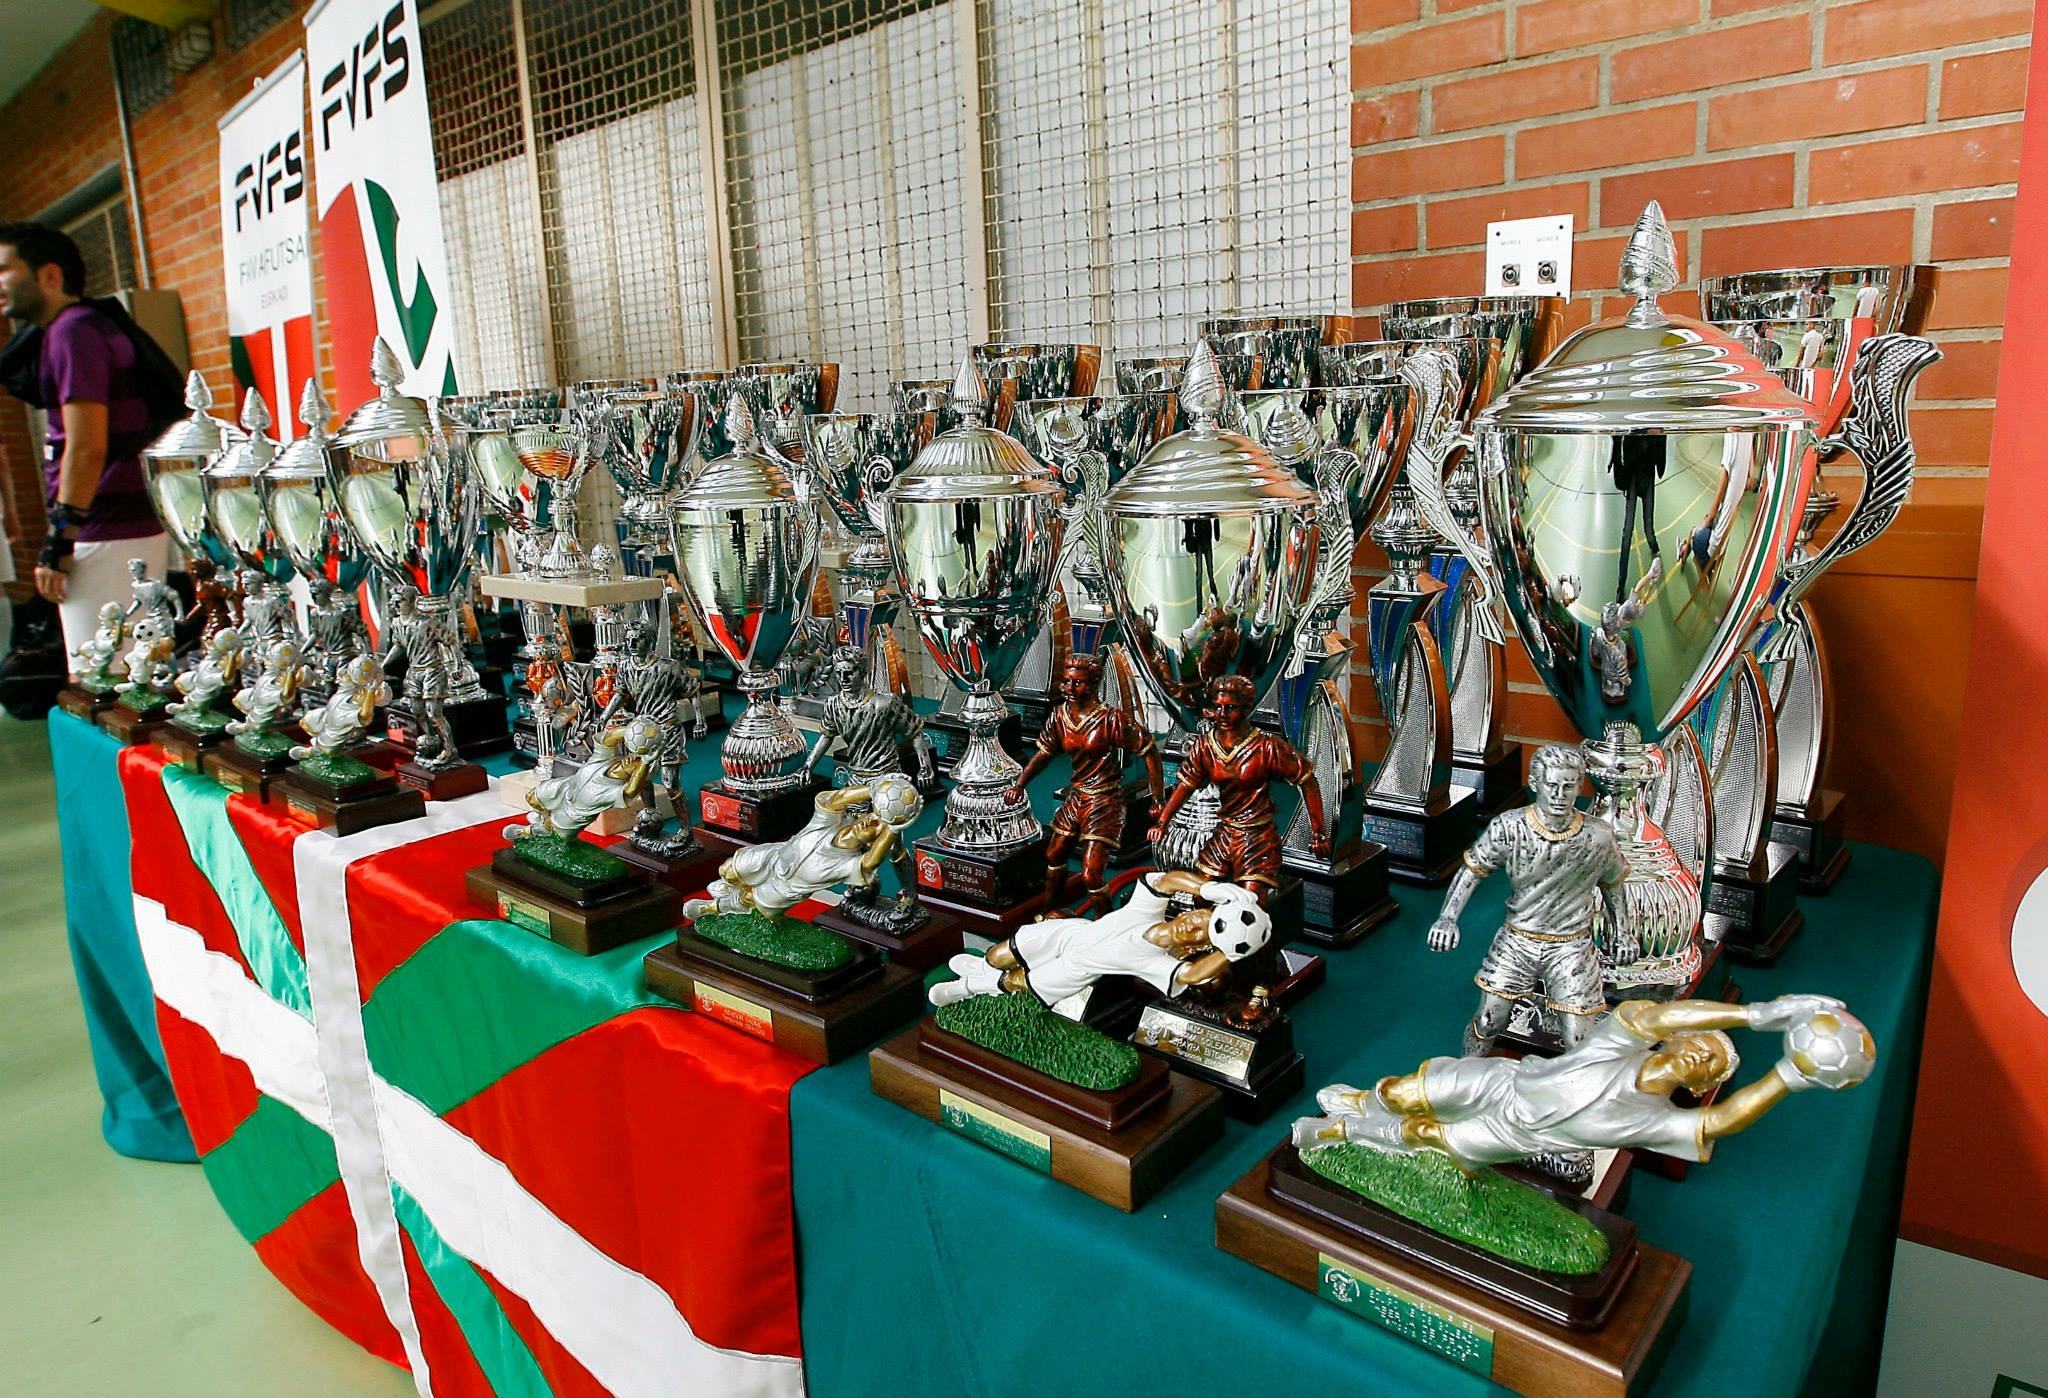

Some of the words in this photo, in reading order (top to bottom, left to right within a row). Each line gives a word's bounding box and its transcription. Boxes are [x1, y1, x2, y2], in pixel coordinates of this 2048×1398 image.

[322, 3, 409, 152] FVFS
[235, 129, 304, 233] FVFS
[1201, 1037, 1244, 1057] GOLEADORA
